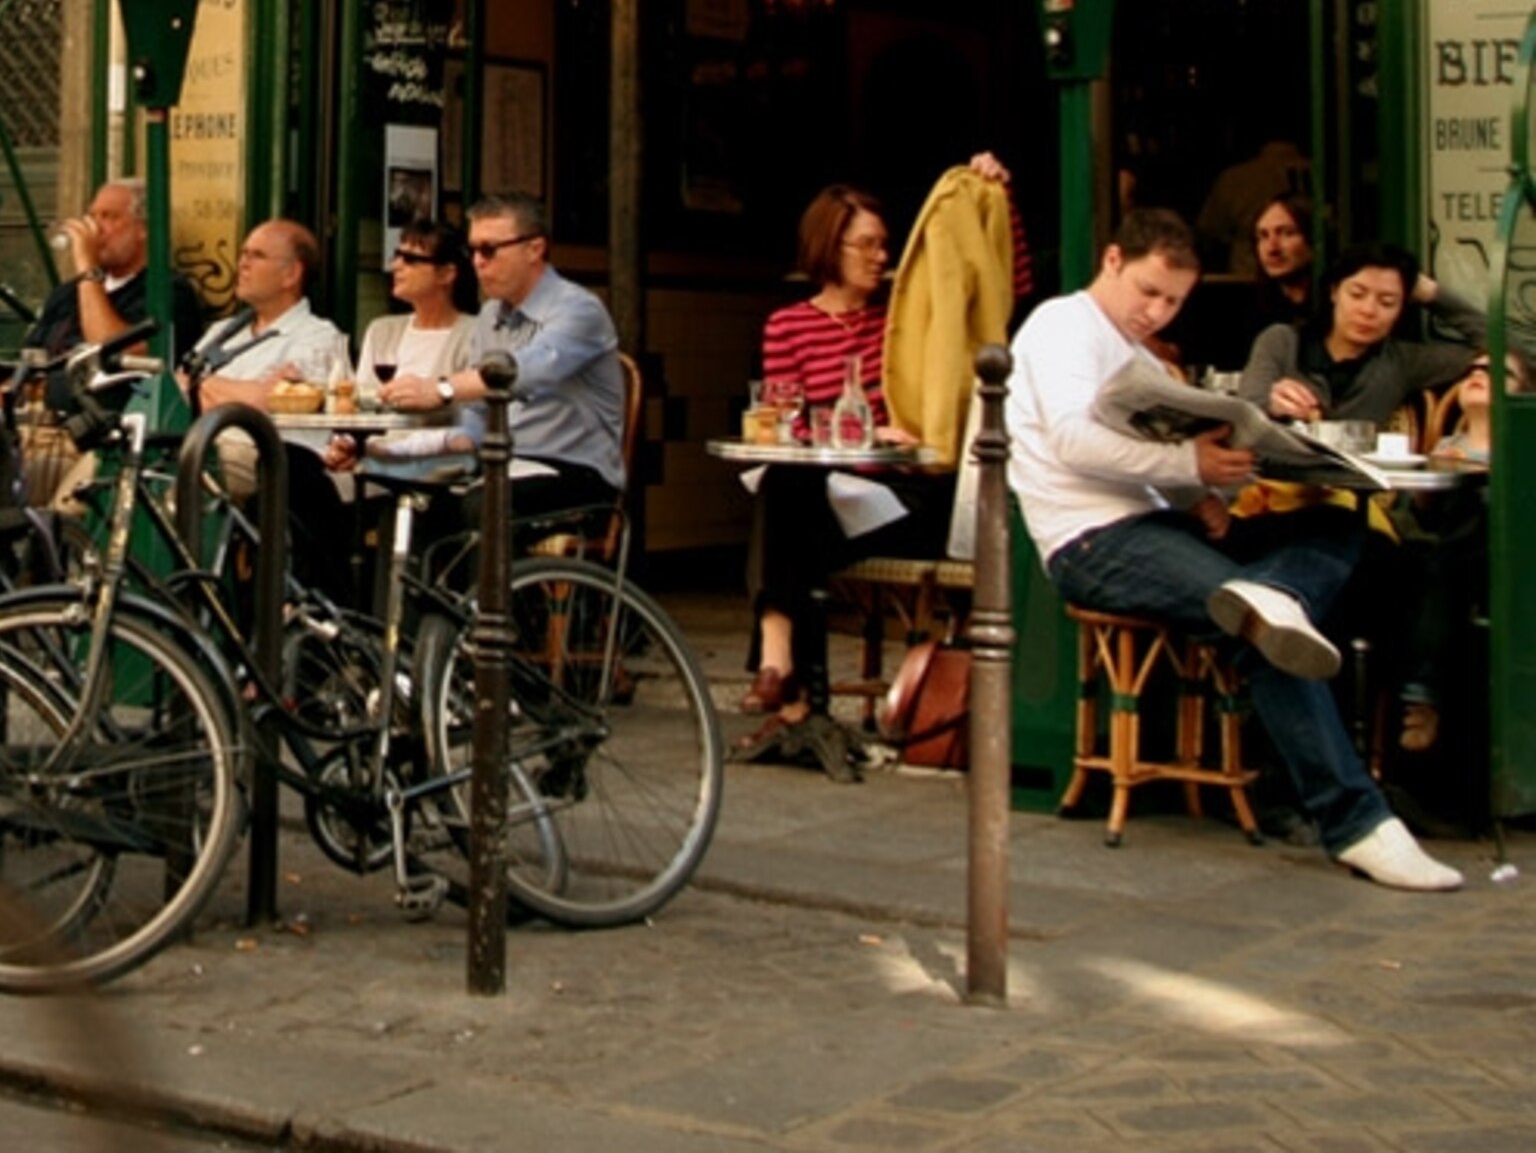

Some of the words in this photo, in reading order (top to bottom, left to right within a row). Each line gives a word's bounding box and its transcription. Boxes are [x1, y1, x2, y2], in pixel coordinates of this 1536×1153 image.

[1434, 39, 1521, 86] BIE
[1435, 117, 1502, 151] BRUNE
[1441, 191, 1505, 221] TELE
